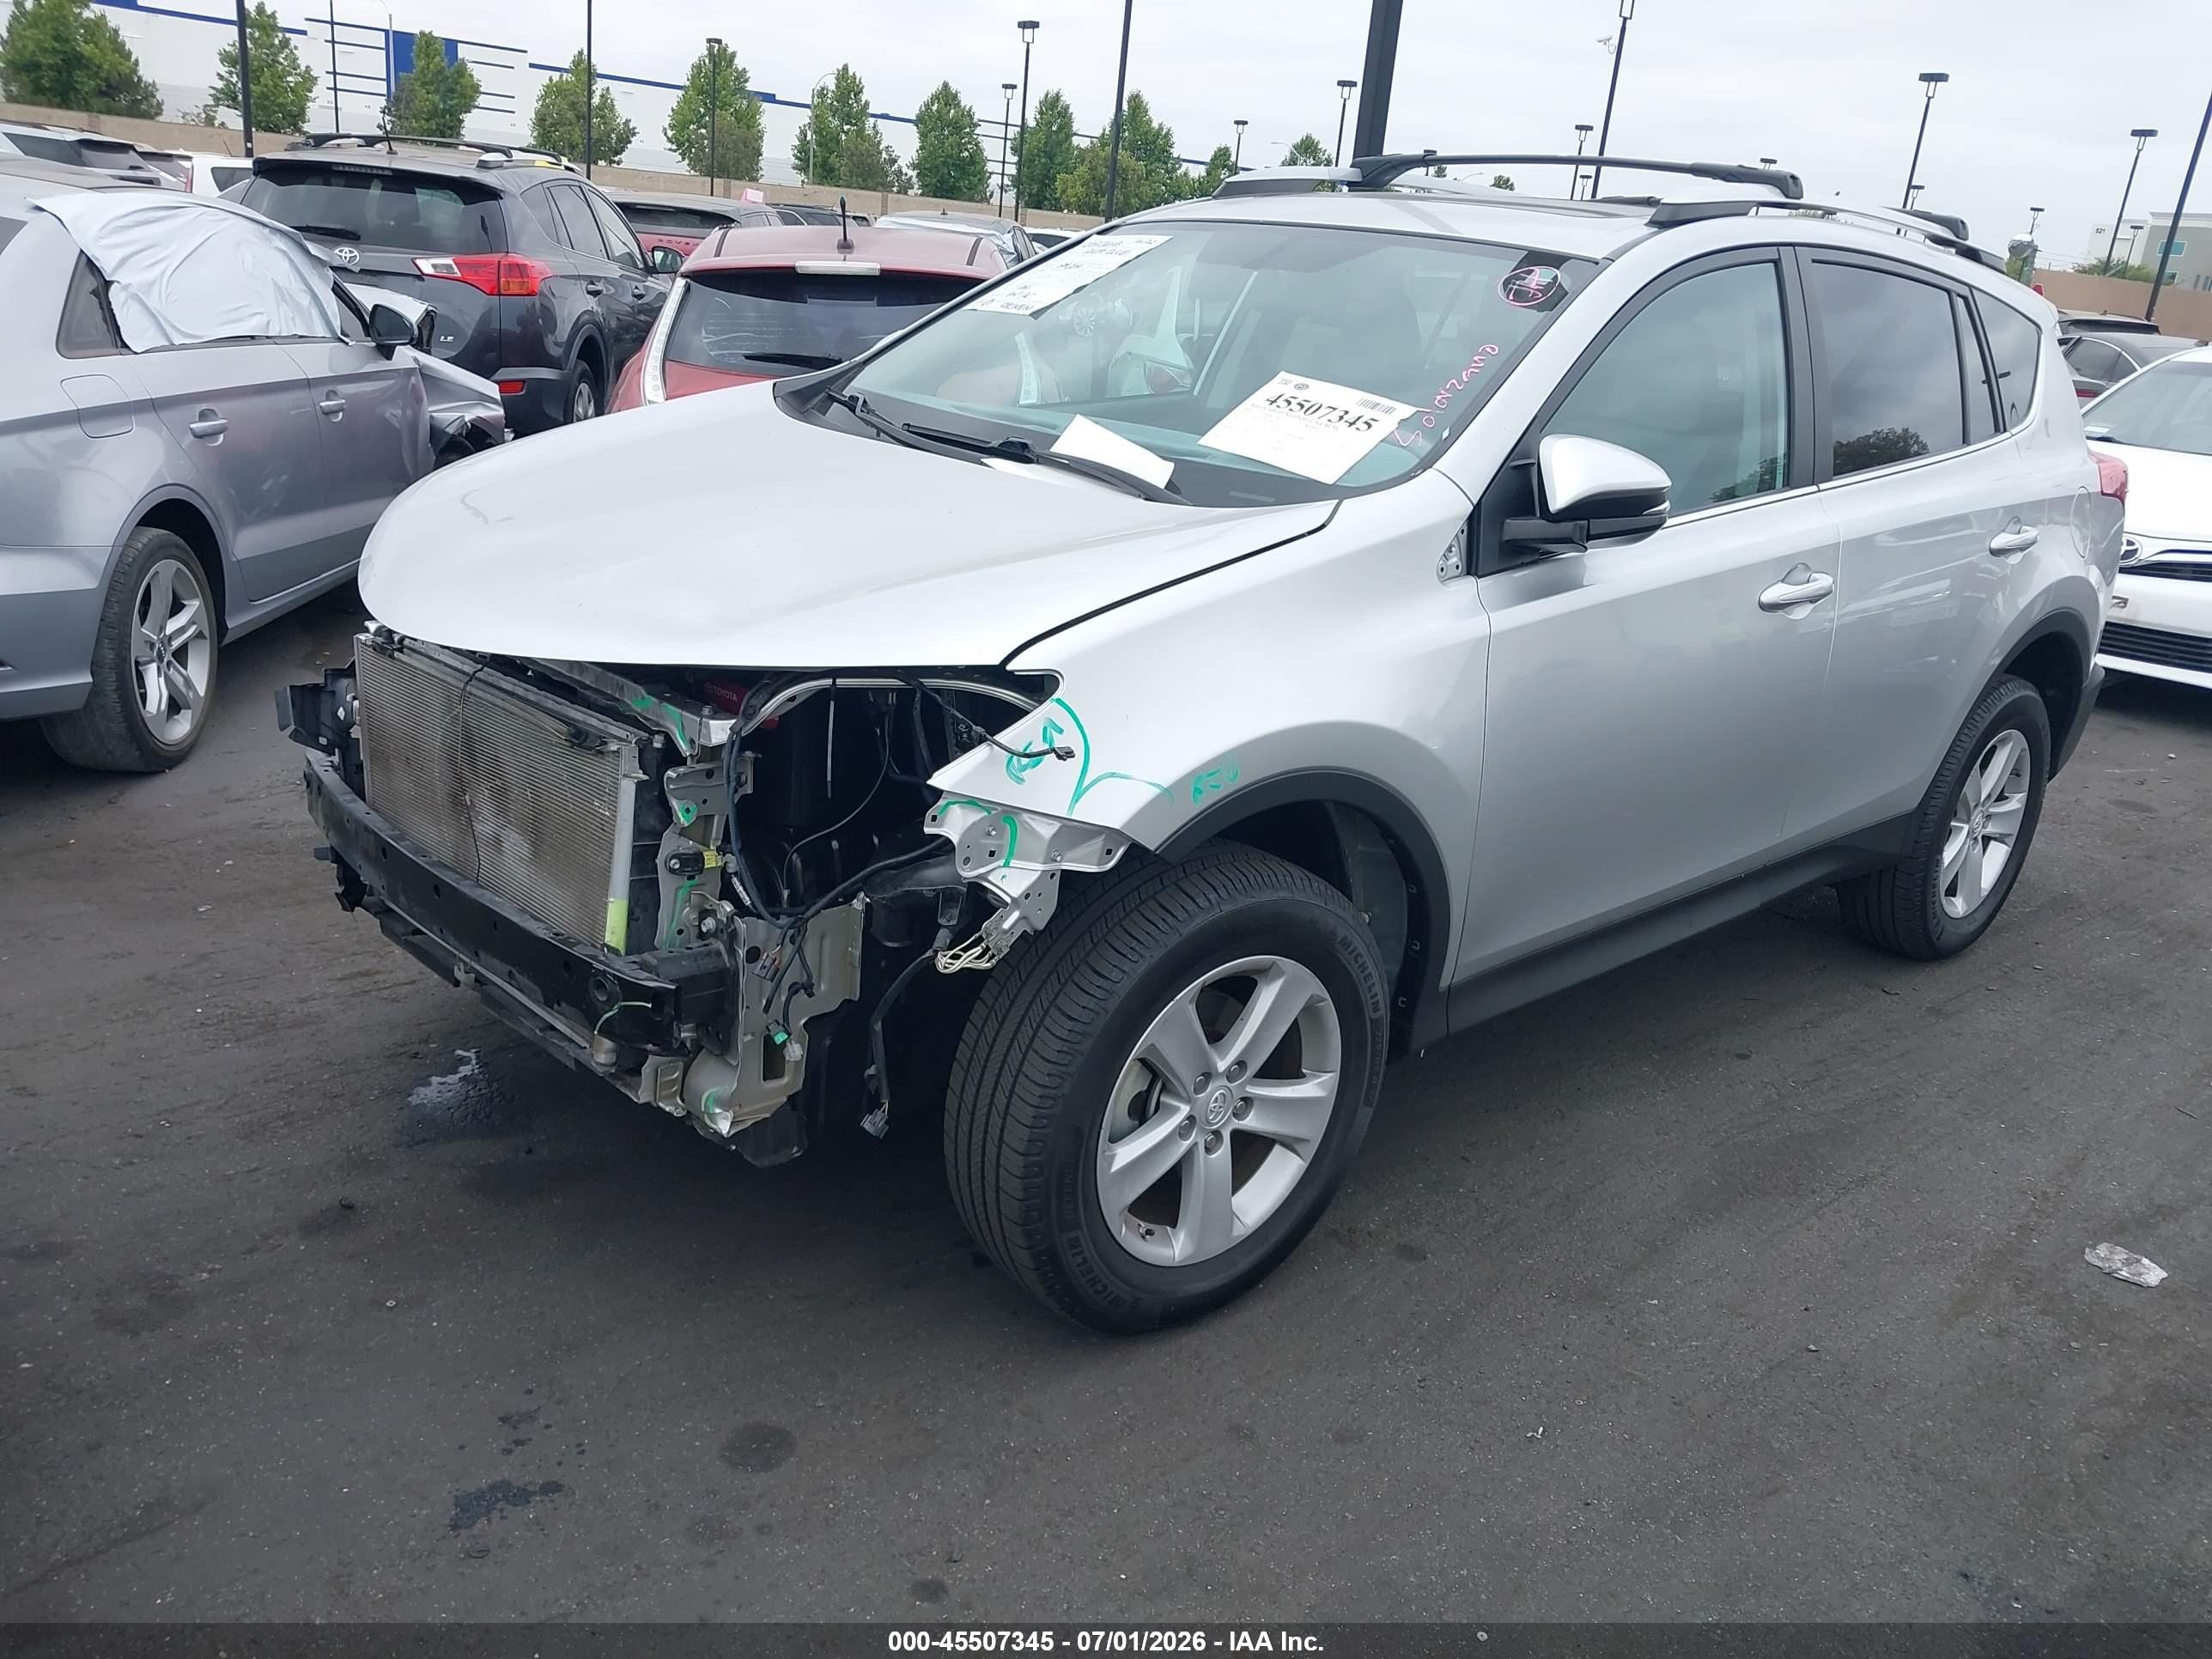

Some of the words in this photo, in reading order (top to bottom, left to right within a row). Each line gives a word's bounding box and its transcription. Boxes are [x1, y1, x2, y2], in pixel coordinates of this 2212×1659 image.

[1265, 392, 1381, 433] 45507345
[714, 686, 738, 702] TOYOTA
[1339, 934, 1382, 1014] MICHELIN
[1067, 1233, 1127, 1307] MICHELIN
